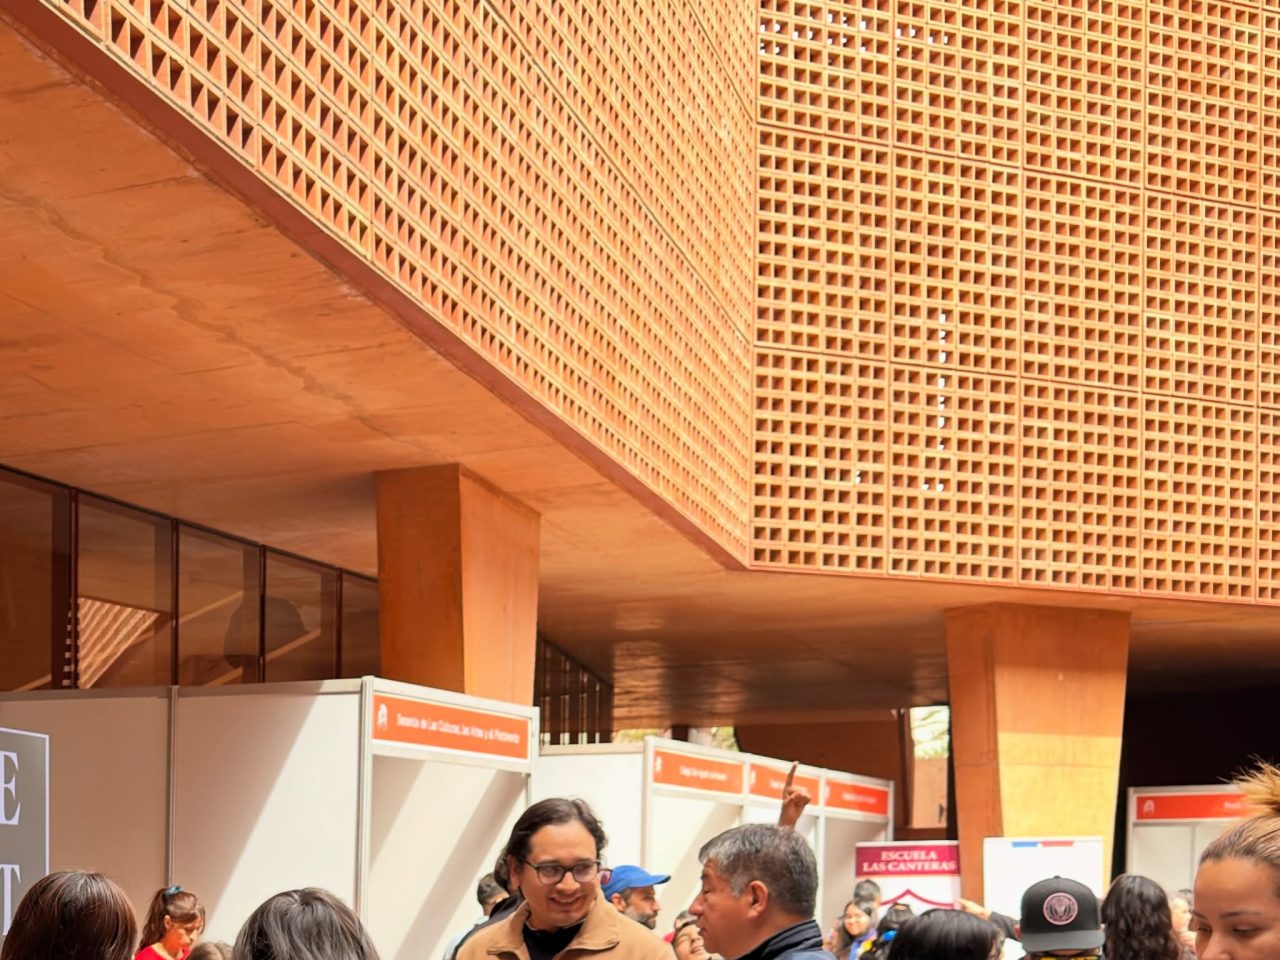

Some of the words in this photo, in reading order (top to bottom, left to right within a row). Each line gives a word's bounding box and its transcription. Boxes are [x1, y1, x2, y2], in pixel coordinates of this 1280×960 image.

[881, 850, 937, 861] ESCUELA
[863, 861, 886, 873] LAS
[888, 861, 956, 872] CANTERAS
